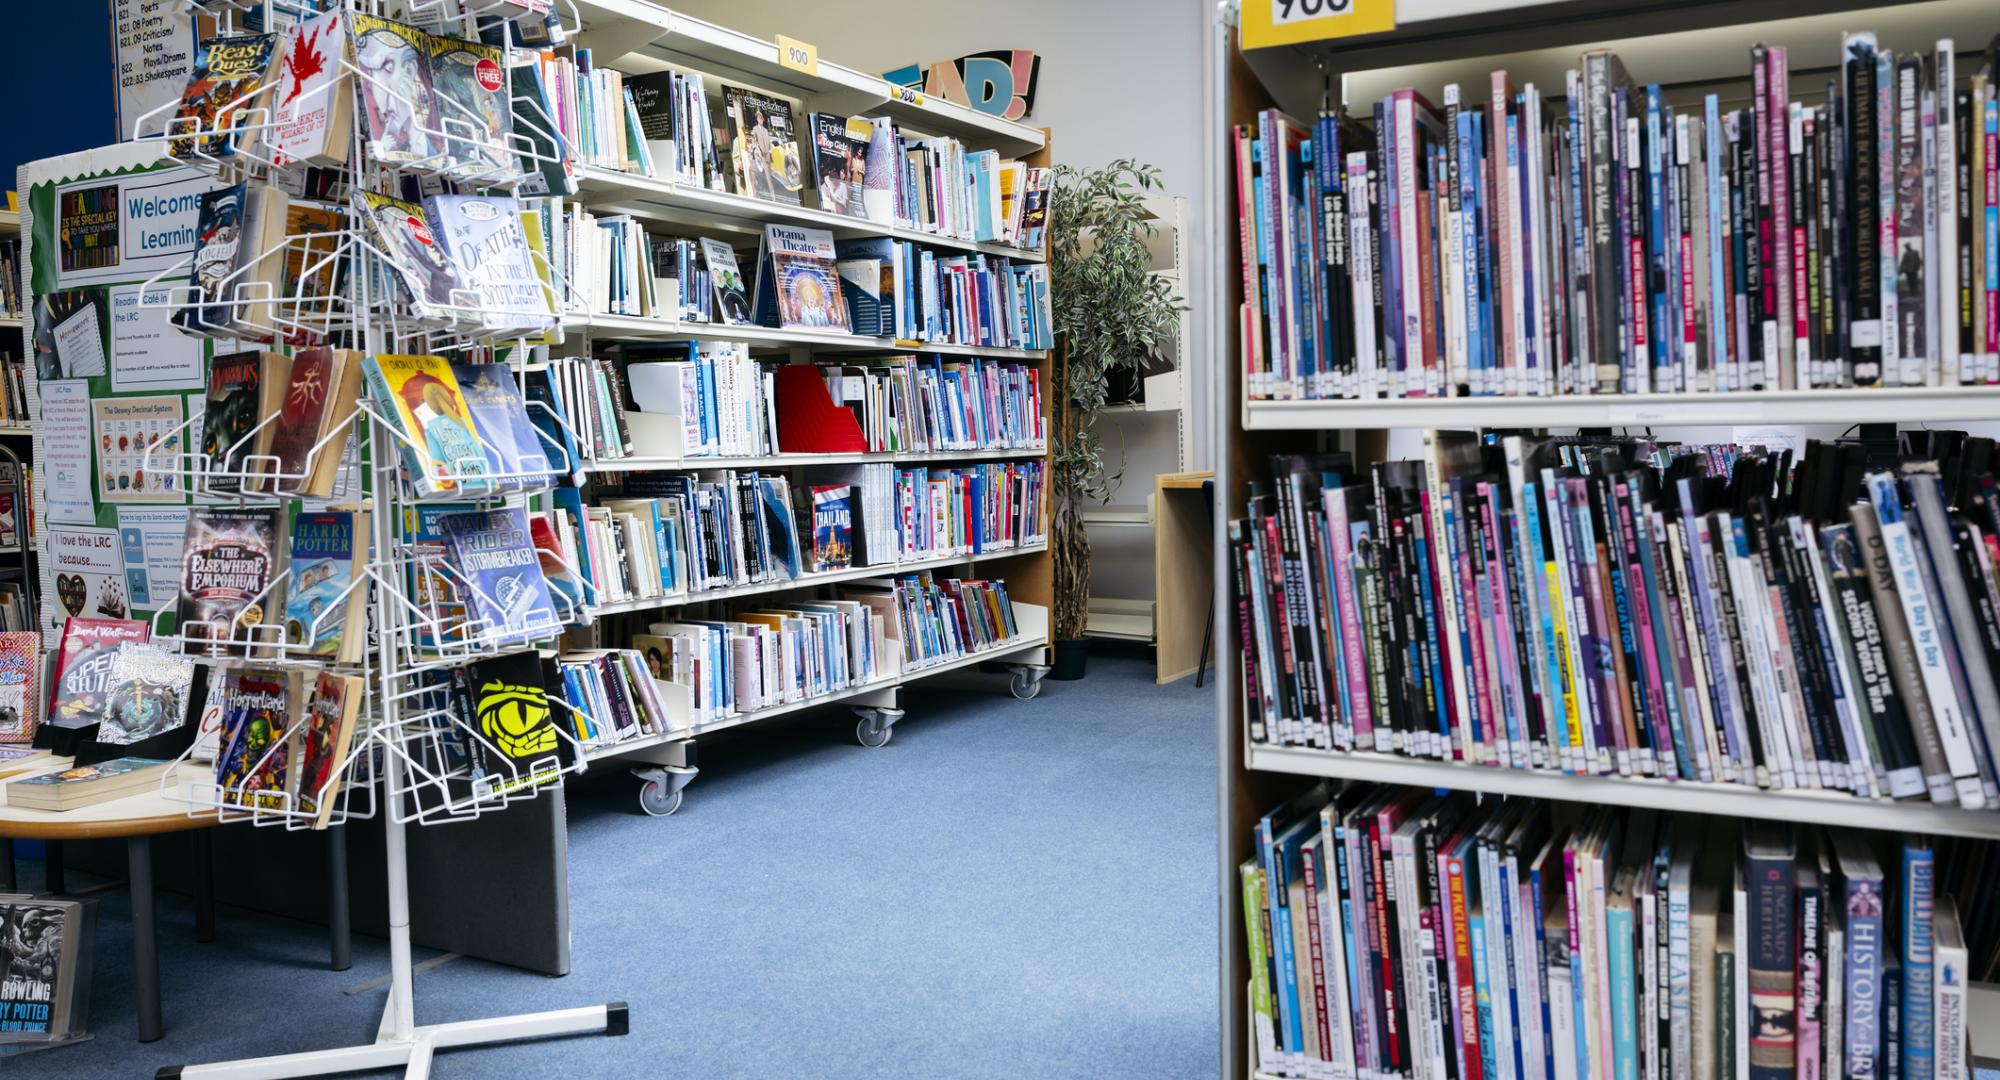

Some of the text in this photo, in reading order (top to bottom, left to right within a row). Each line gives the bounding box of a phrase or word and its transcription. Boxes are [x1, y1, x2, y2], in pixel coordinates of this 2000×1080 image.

[118, 2, 158, 20] 821 Poets
[142, 16, 163, 28] Poetry
[143, 43, 163, 54] Notes
[207, 42, 265, 62] Beast
[789, 46, 808, 66] 900
[121, 52, 186, 74] 822 Plays/Drama
[210, 57, 256, 74] Quest
[122, 66, 187, 88] 822.33 Shakespeare
[479, 72, 500, 83] FREE
[1900, 69, 1916, 109] WORLD
[900, 88, 915, 103] 900
[1855, 70, 1870, 136] ULTIMATE
[1901, 111, 1917, 135] WAR
[1858, 140, 1870, 175] BOOK
[1899, 148, 1914, 173] Day
[1399, 136, 1412, 209] CRUSADES
[1939, 130, 1952, 213] FIRST WORLD WAR
[1450, 178, 1459, 211] GUIDES
[1899, 179, 1914, 197] by
[128, 192, 202, 220] Welcome
[1900, 202, 1915, 228] Day
[772, 227, 806, 240] Drama
[1451, 218, 1461, 264] KNIGHT
[1858, 208, 1871, 258] WORLD
[460, 226, 511, 272] DEATH
[782, 239, 816, 254] Theatre
[1371, 228, 1382, 306] MEDIEVAL EUROPE
[1858, 261, 1872, 289] WAR
[114, 406, 131, 415] Dewey
[154, 405, 173, 414] System
[299, 524, 350, 537] HARRY
[464, 512, 514, 531] ALEX
[816, 509, 850, 528] THAILAND
[60, 534, 76, 546] love
[78, 535, 92, 547] the
[94, 536, 112, 548] LRC
[297, 538, 350, 551] POTTER
[464, 530, 524, 550] RIDER
[1333, 521, 1347, 562] SECOND
[1892, 534, 1914, 567] World
[191, 554, 264, 574] ELSEWHERE
[219, 548, 240, 558] THE
[465, 548, 534, 571] STORMBREAKER
[1867, 534, 1895, 595] D-DAY
[191, 573, 260, 592] EMPORIUM
[1336, 565, 1351, 600] WORLD
[1365, 575, 1377, 606] VOICES
[1899, 569, 1917, 591] War
[1284, 560, 1300, 627] RATIONING
[1293, 560, 1308, 627] RATIONING
[1340, 603, 1354, 625] WAR
[1611, 570, 1633, 654] EVACUATION
[1714, 552, 1745, 667] Germany and Japan Attack
[1911, 605, 1930, 627] Day
[66, 625, 140, 638] David Walliams
[1916, 630, 1933, 644] by
[1372, 639, 1385, 672] SECOND
[1841, 589, 1886, 714] SECOND WORLD WAR
[1860, 600, 1892, 696] VOICES FROM THE
[1921, 646, 1940, 668] Day
[10, 656, 24, 666] Kid
[1242, 658, 1253, 673] TO
[1347, 641, 1362, 682] COLOUR
[1245, 677, 1257, 699] WAR
[1375, 674, 1388, 704] WORLD
[1899, 640, 1939, 755] RICHARD COLLIER
[1379, 706, 1390, 725] WAR
[1425, 834, 1444, 960] THE STORY OF THE HOLOCAUST
[1761, 885, 1773, 961] HERITAGE
[1774, 885, 1786, 962] ENGLAND'S
[1670, 902, 1688, 1019] BELFAST
[1804, 897, 1817, 1018] TIMELINE OF BRITAIN
[1853, 923, 1875, 1027] HISTORY
[1, 980, 50, 1001] ROWLING
[13, 1003, 48, 1020] POTTER
[1385, 989, 1396, 1034] Alex Woolf
[1460, 986, 1476, 1044] WINDRUSH
[1479, 1006, 1492, 1034] Black
[24, 1022, 46, 1033] PRINCE
[1940, 992, 1950, 1078] BRITISH HISTORY
